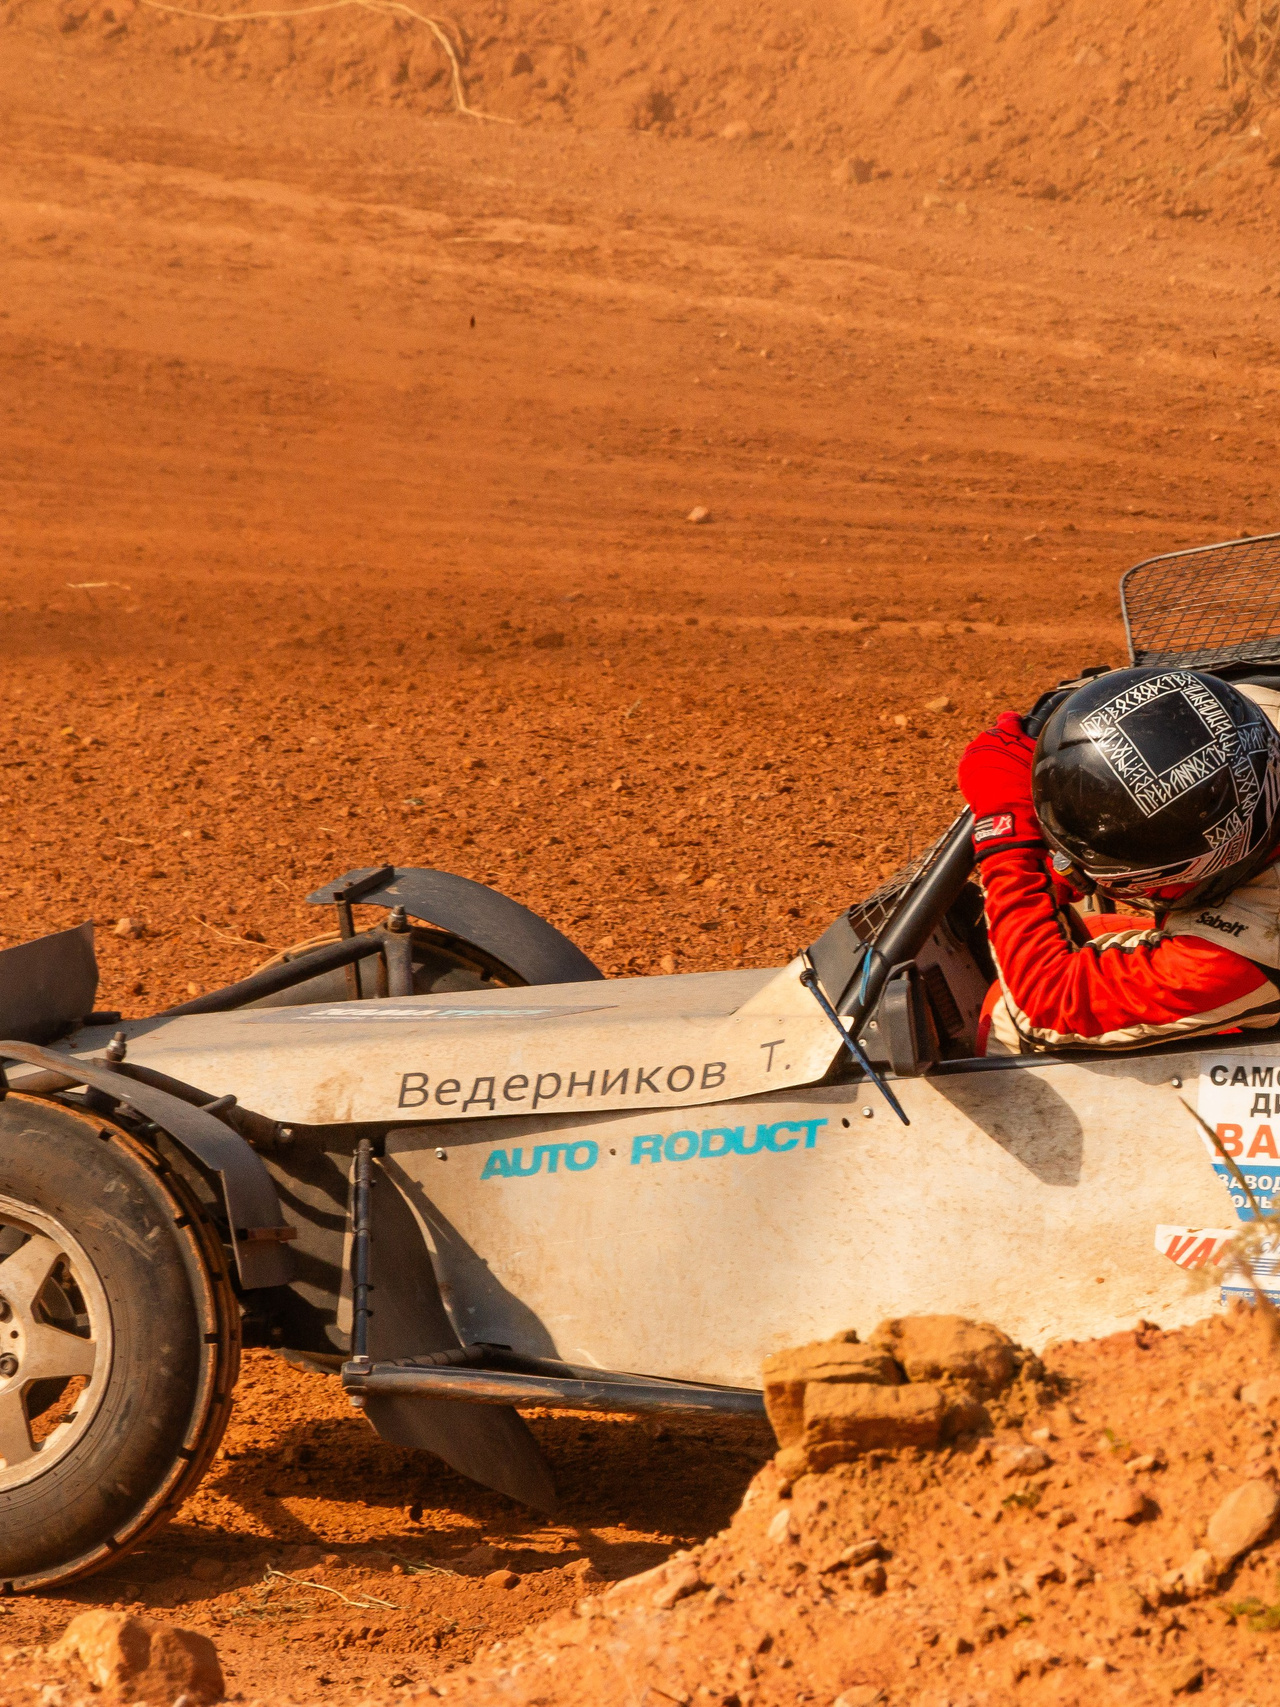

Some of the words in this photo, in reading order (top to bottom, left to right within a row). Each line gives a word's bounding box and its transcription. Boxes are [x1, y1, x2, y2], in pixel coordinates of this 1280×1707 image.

[1195, 911, 1246, 938] Sabelt
[397, 1060, 727, 1112] Ведерников
[480, 1140, 599, 1179] AUTO
